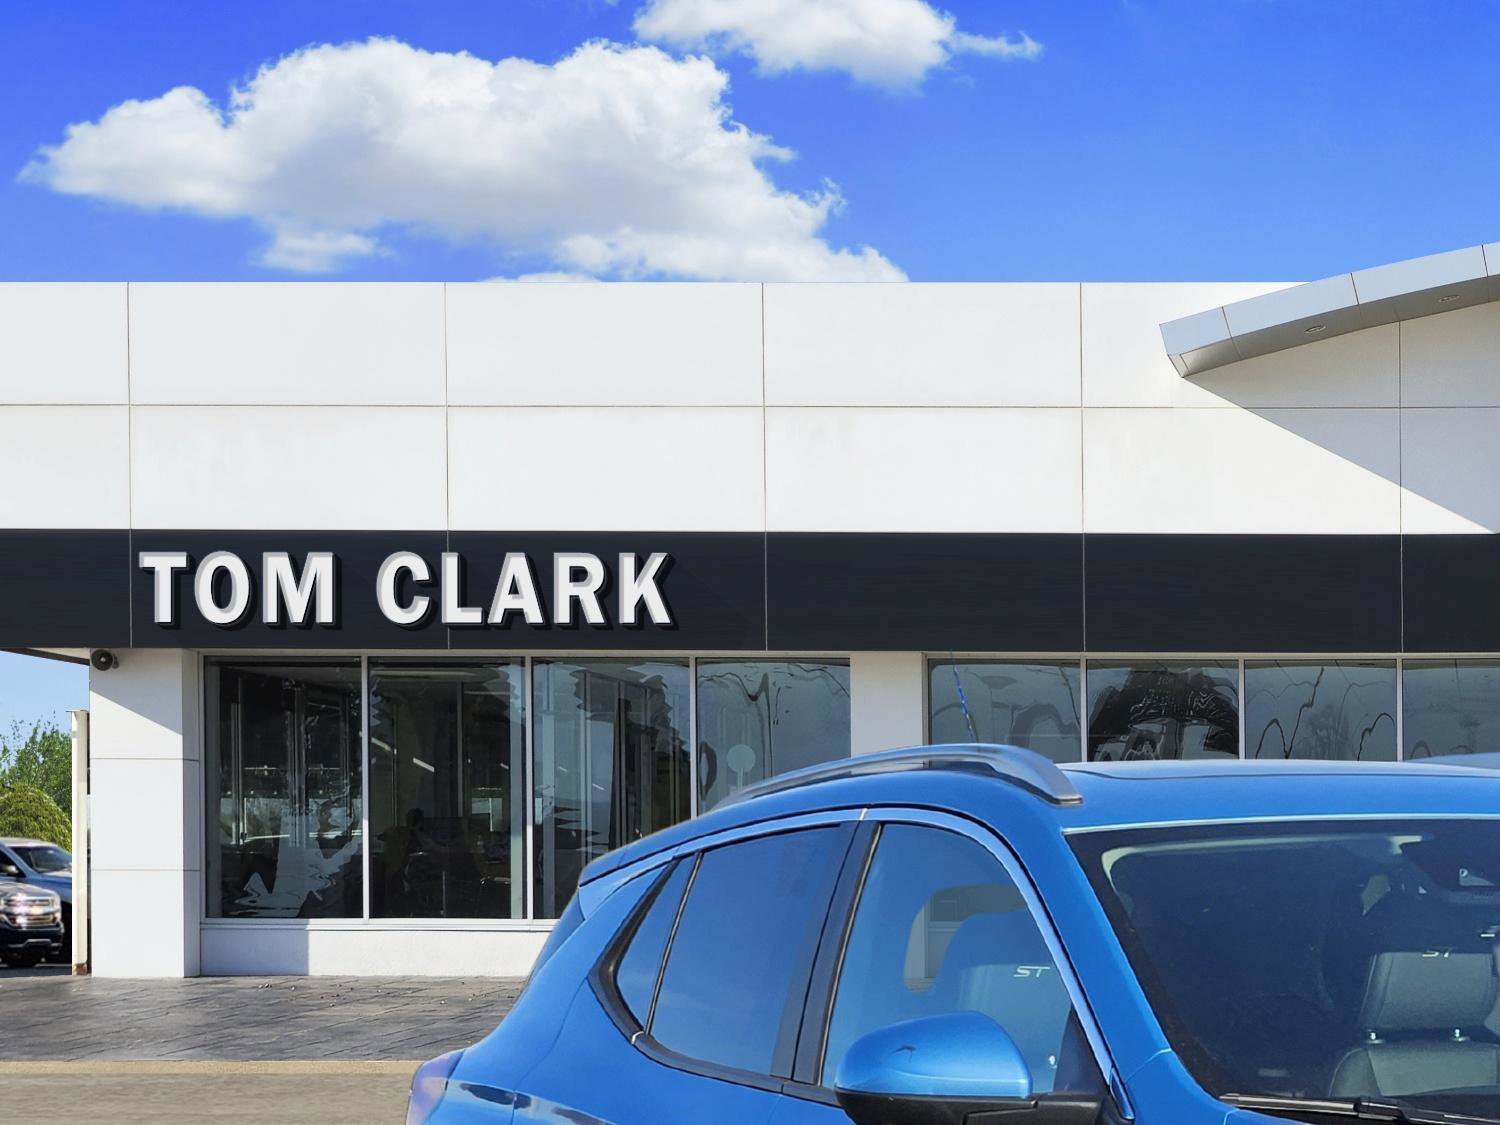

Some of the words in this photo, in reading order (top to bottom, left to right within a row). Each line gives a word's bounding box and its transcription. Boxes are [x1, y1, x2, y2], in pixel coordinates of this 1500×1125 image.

[139, 550, 334, 624] TOM
[376, 551, 672, 624] CLARK
[1013, 965, 1051, 978] ST
